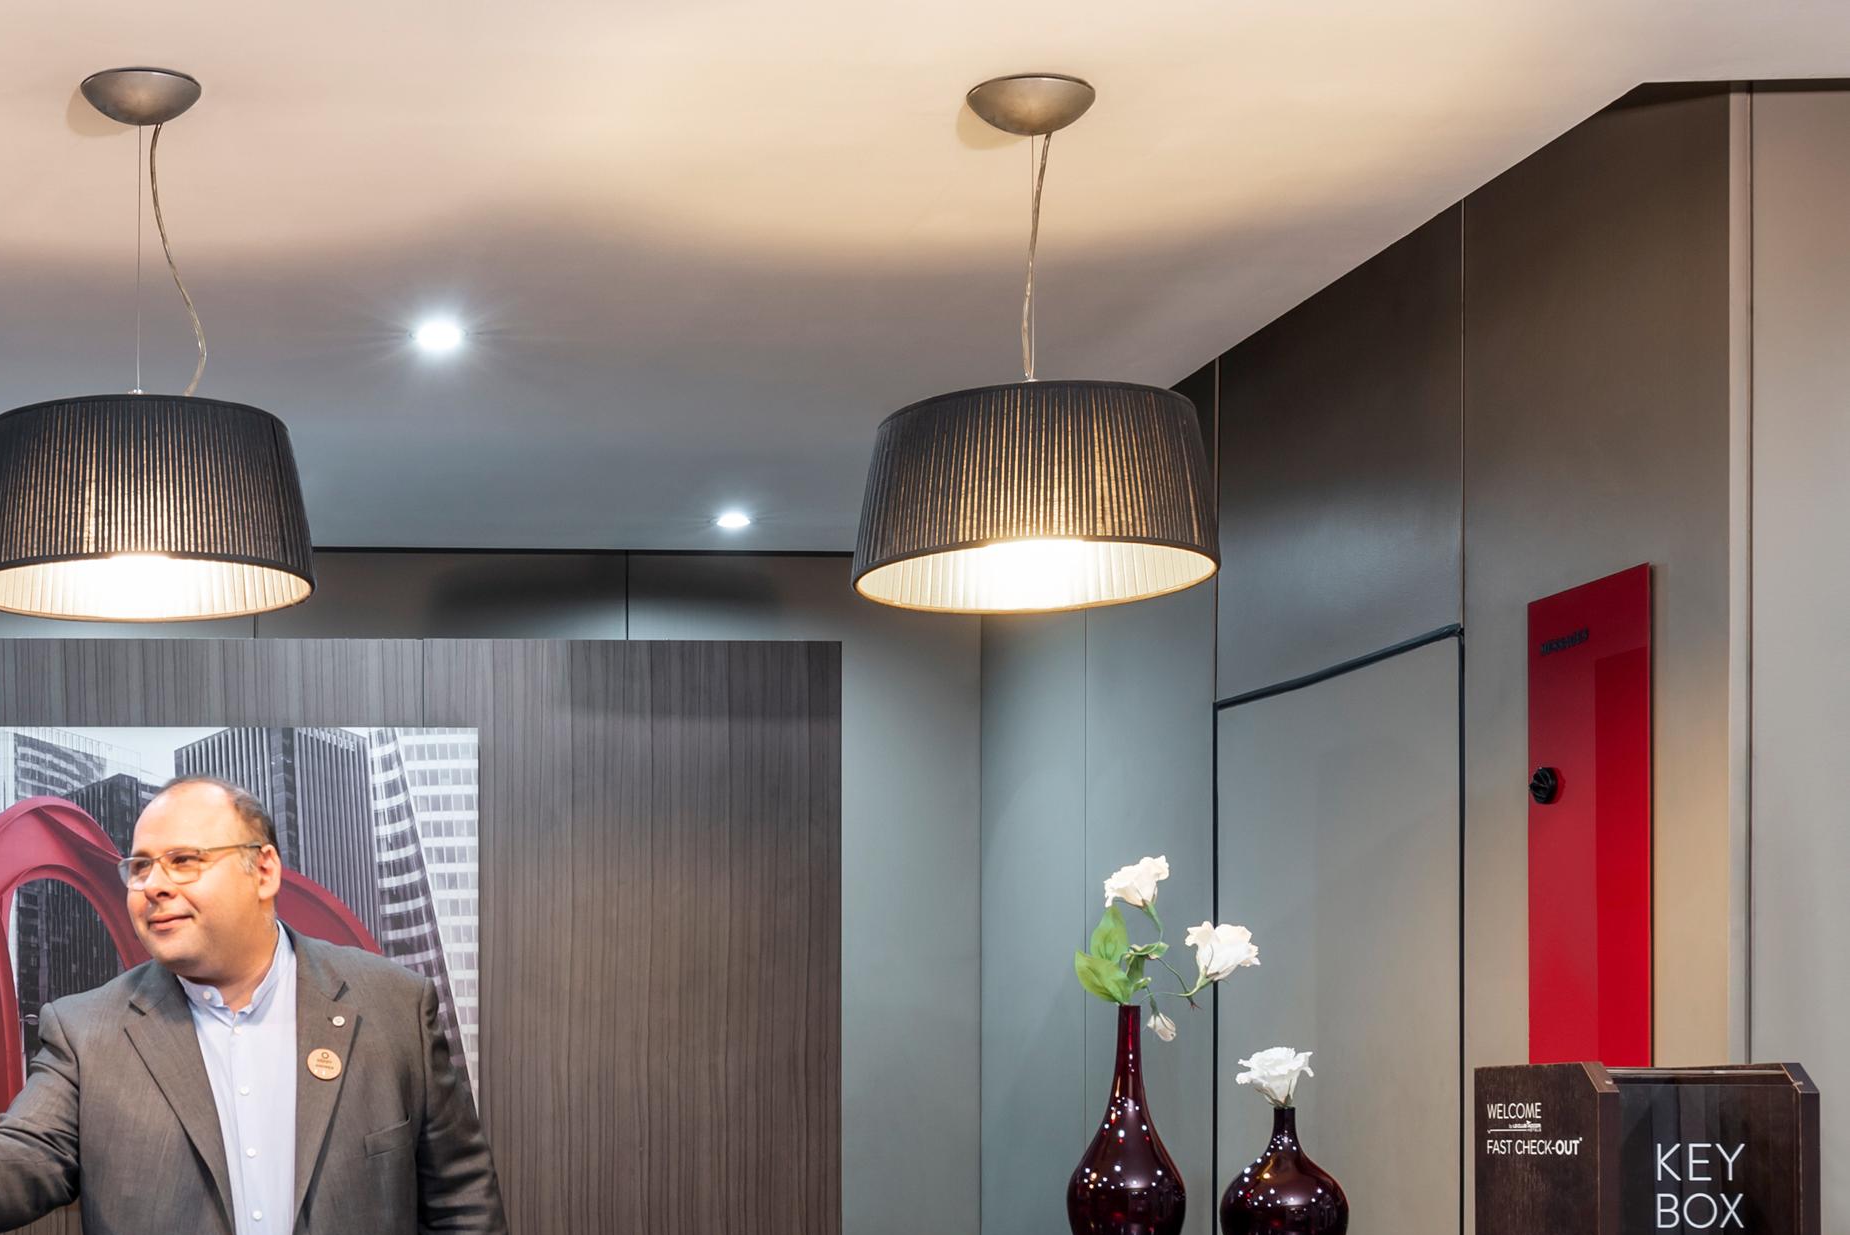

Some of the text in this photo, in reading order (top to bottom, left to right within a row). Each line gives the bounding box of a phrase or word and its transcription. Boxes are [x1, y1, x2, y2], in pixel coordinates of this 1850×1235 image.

[1486, 1102, 1542, 1119] WELCOME
[1486, 1139, 1513, 1155] FAST
[1656, 1142, 1746, 1182] KEY
[1656, 1192, 1745, 1229] BOX
